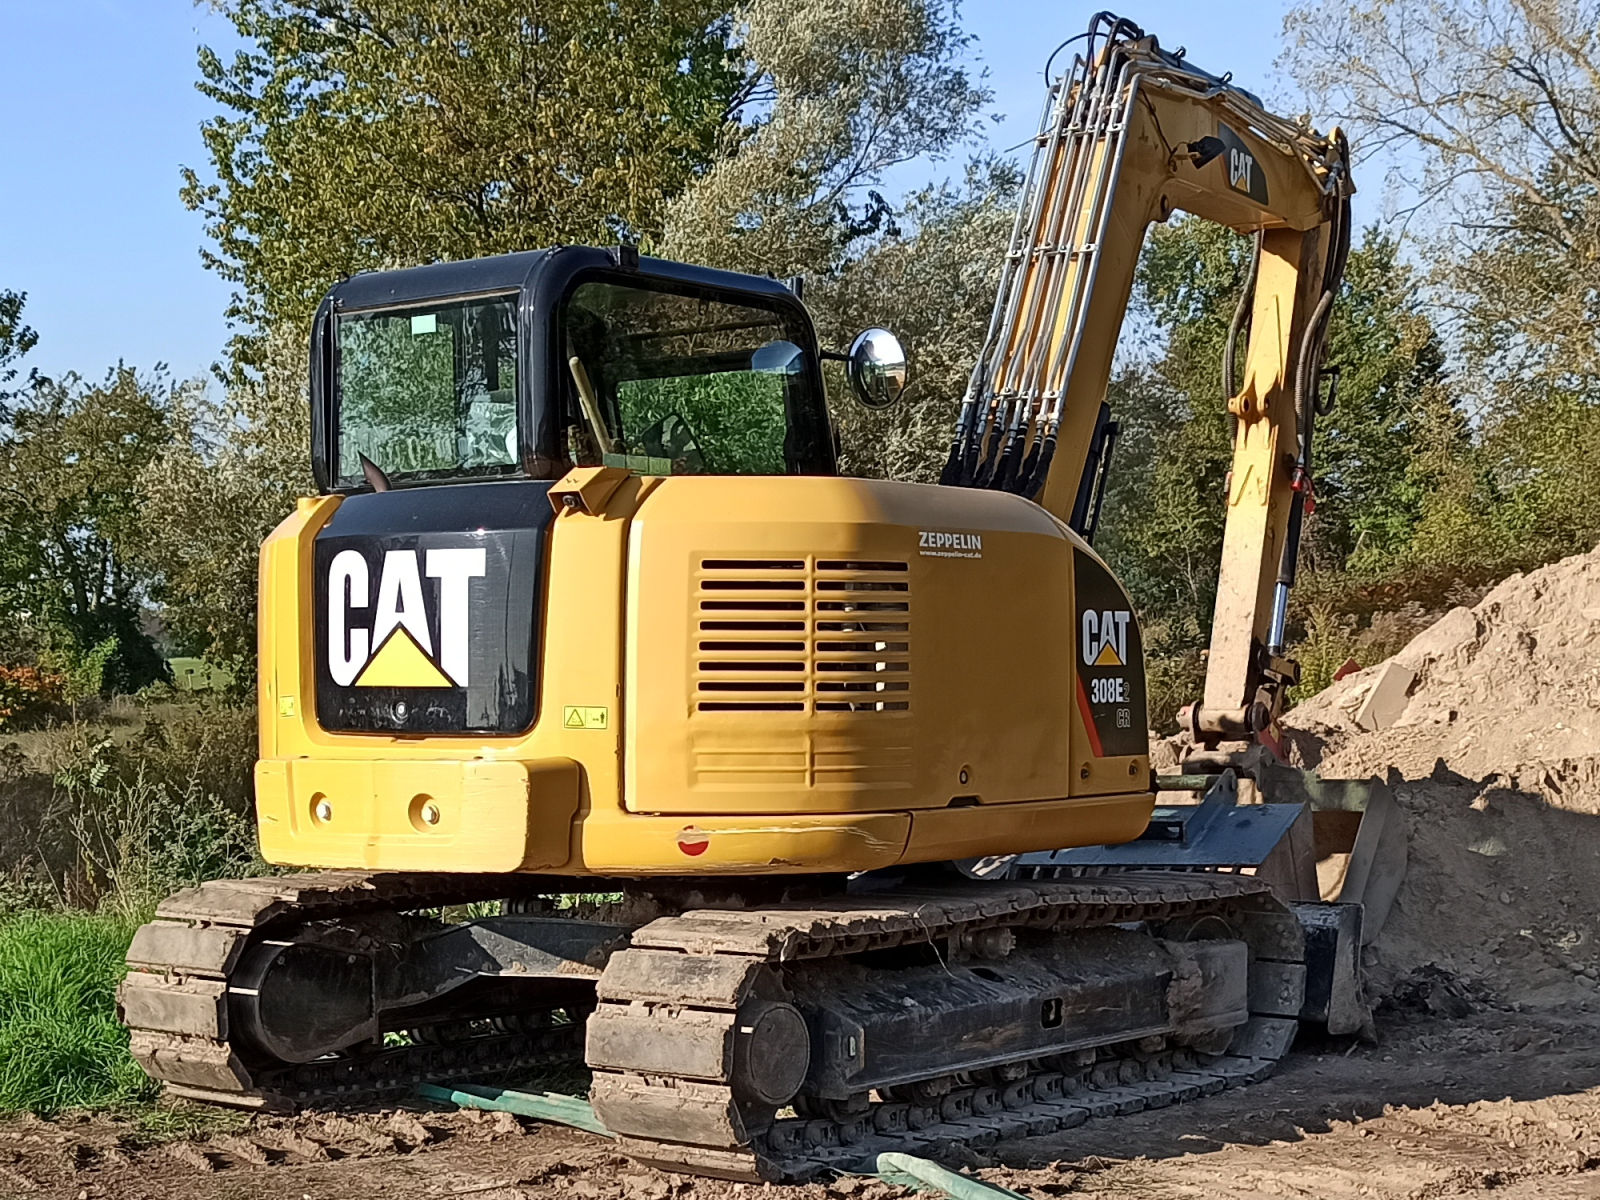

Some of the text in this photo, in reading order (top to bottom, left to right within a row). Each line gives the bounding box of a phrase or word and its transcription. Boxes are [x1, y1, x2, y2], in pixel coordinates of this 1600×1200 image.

[1230, 147, 1253, 193] CAT
[918, 531, 982, 550] ZEPPELIN
[328, 547, 487, 688] CAT
[1082, 609, 1131, 666] CAT
[1116, 708, 1131, 728] CR
